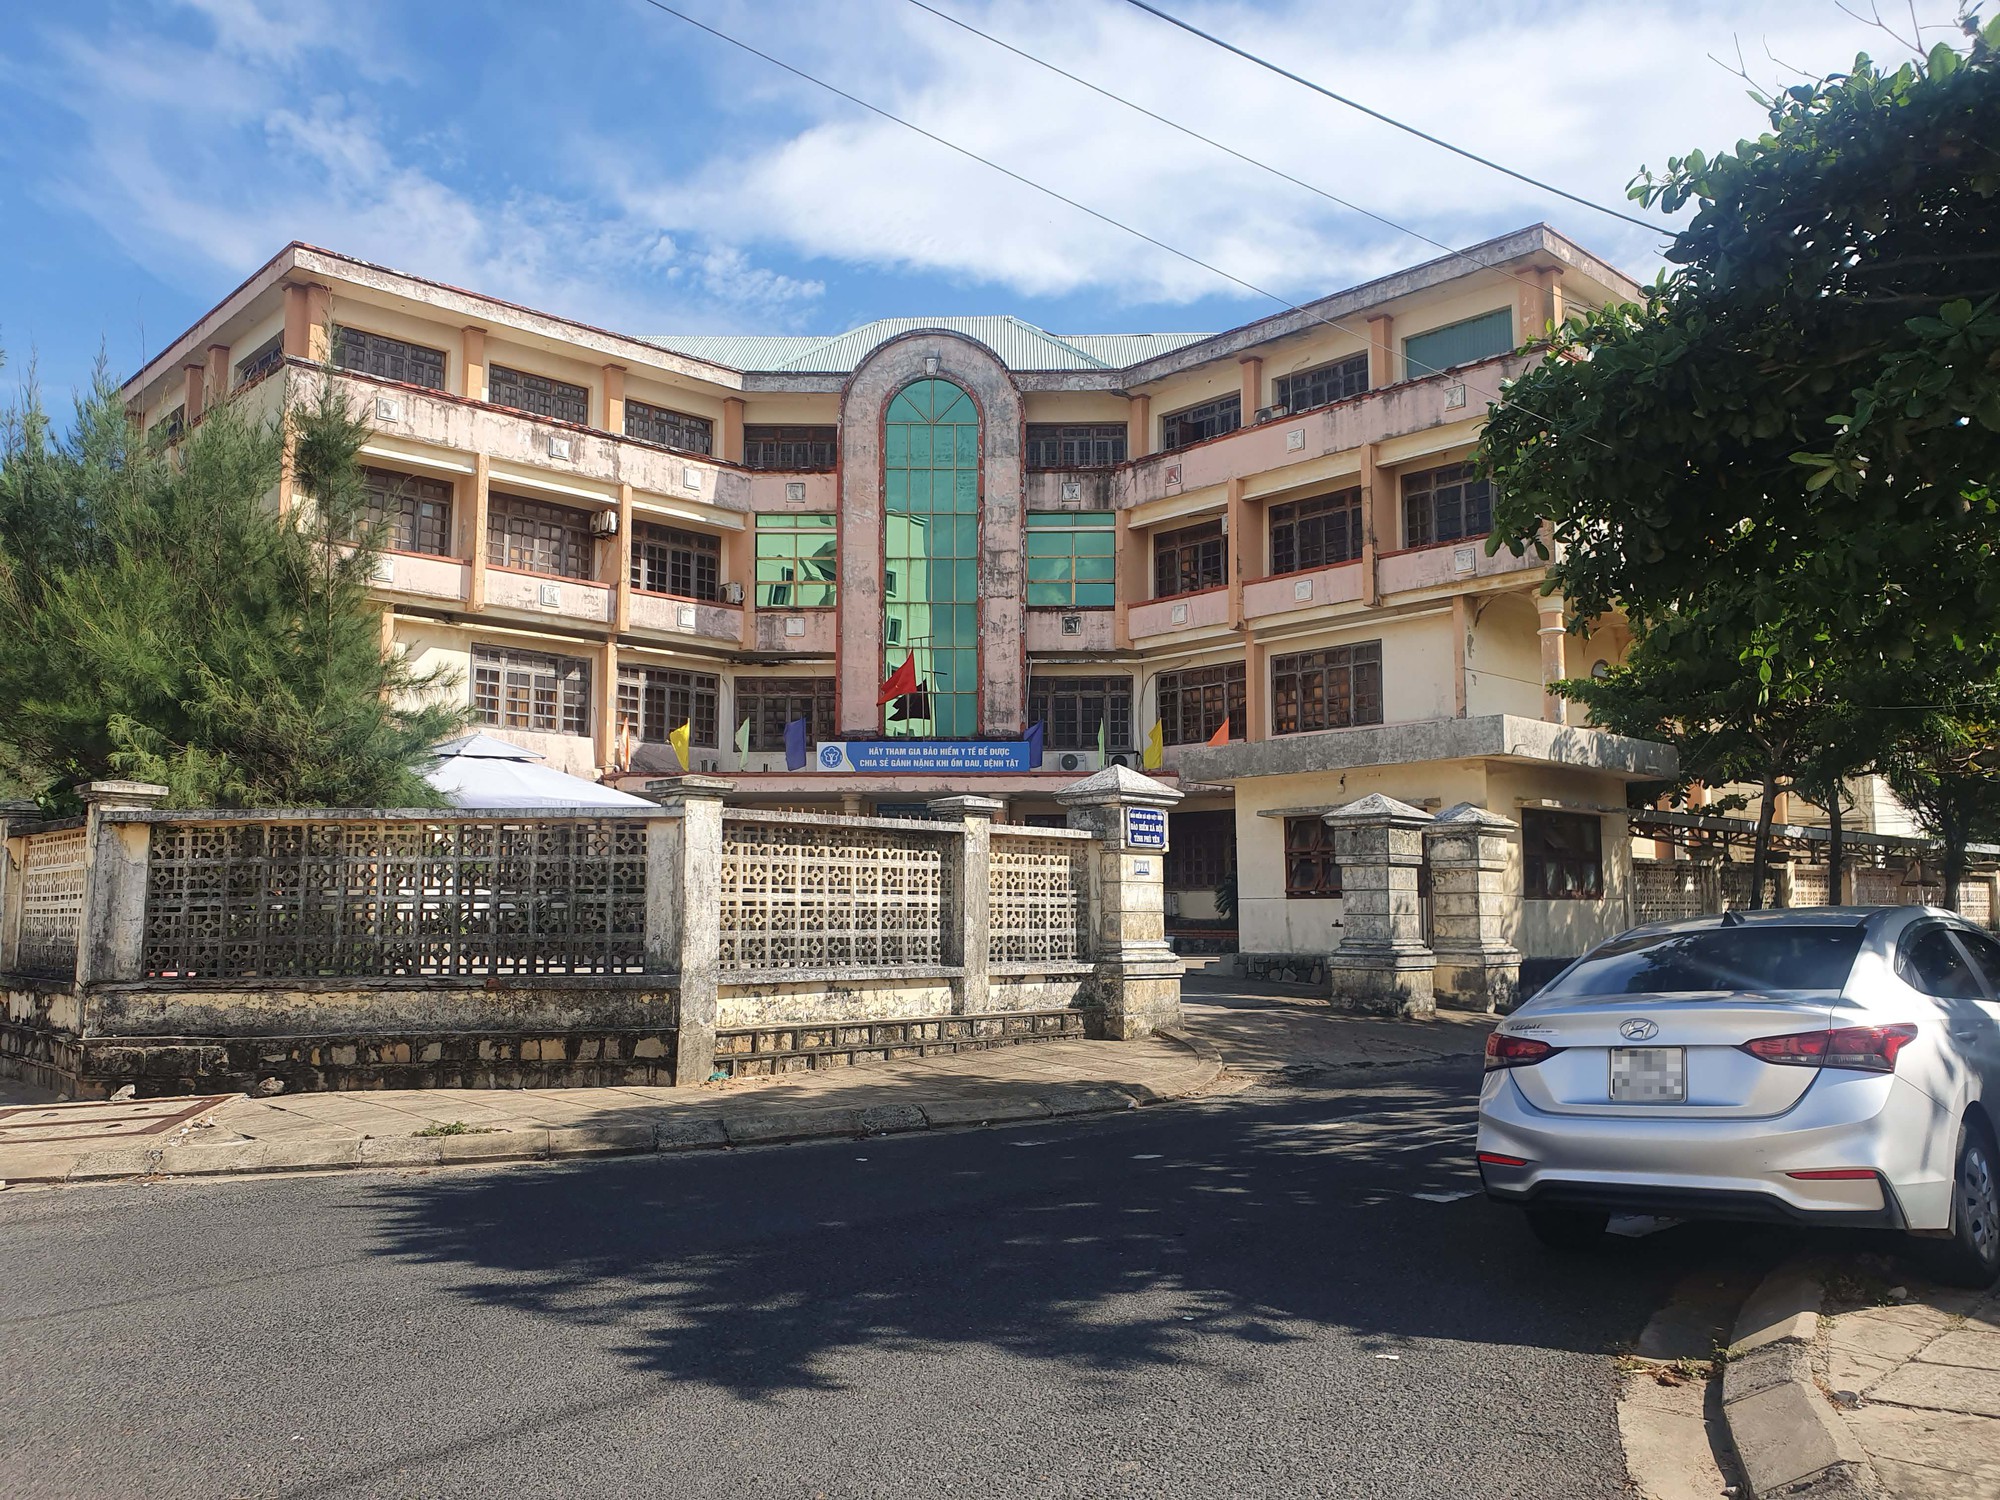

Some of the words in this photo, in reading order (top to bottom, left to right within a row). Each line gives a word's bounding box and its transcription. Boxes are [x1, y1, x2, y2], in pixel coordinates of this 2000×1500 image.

[885, 747, 906, 756] THAM
[908, 747, 921, 756] GIA
[922, 745, 938, 756] BẢO
[940, 745, 959, 756] HIỂM
[961, 748, 966, 756] Y
[967, 746, 977, 756] TẾ
[989, 747, 1010, 757] ĐƯỢC
[859, 759, 877, 767] CHIA
[890, 758, 912, 767] GÁNH
[913, 758, 935, 769] NẶNG
[936, 759, 949, 767] KHI
[950, 758, 963, 767] ỐM
[983, 758, 1004, 769] BỆNH
[1005, 758, 1020, 768] TẬT
